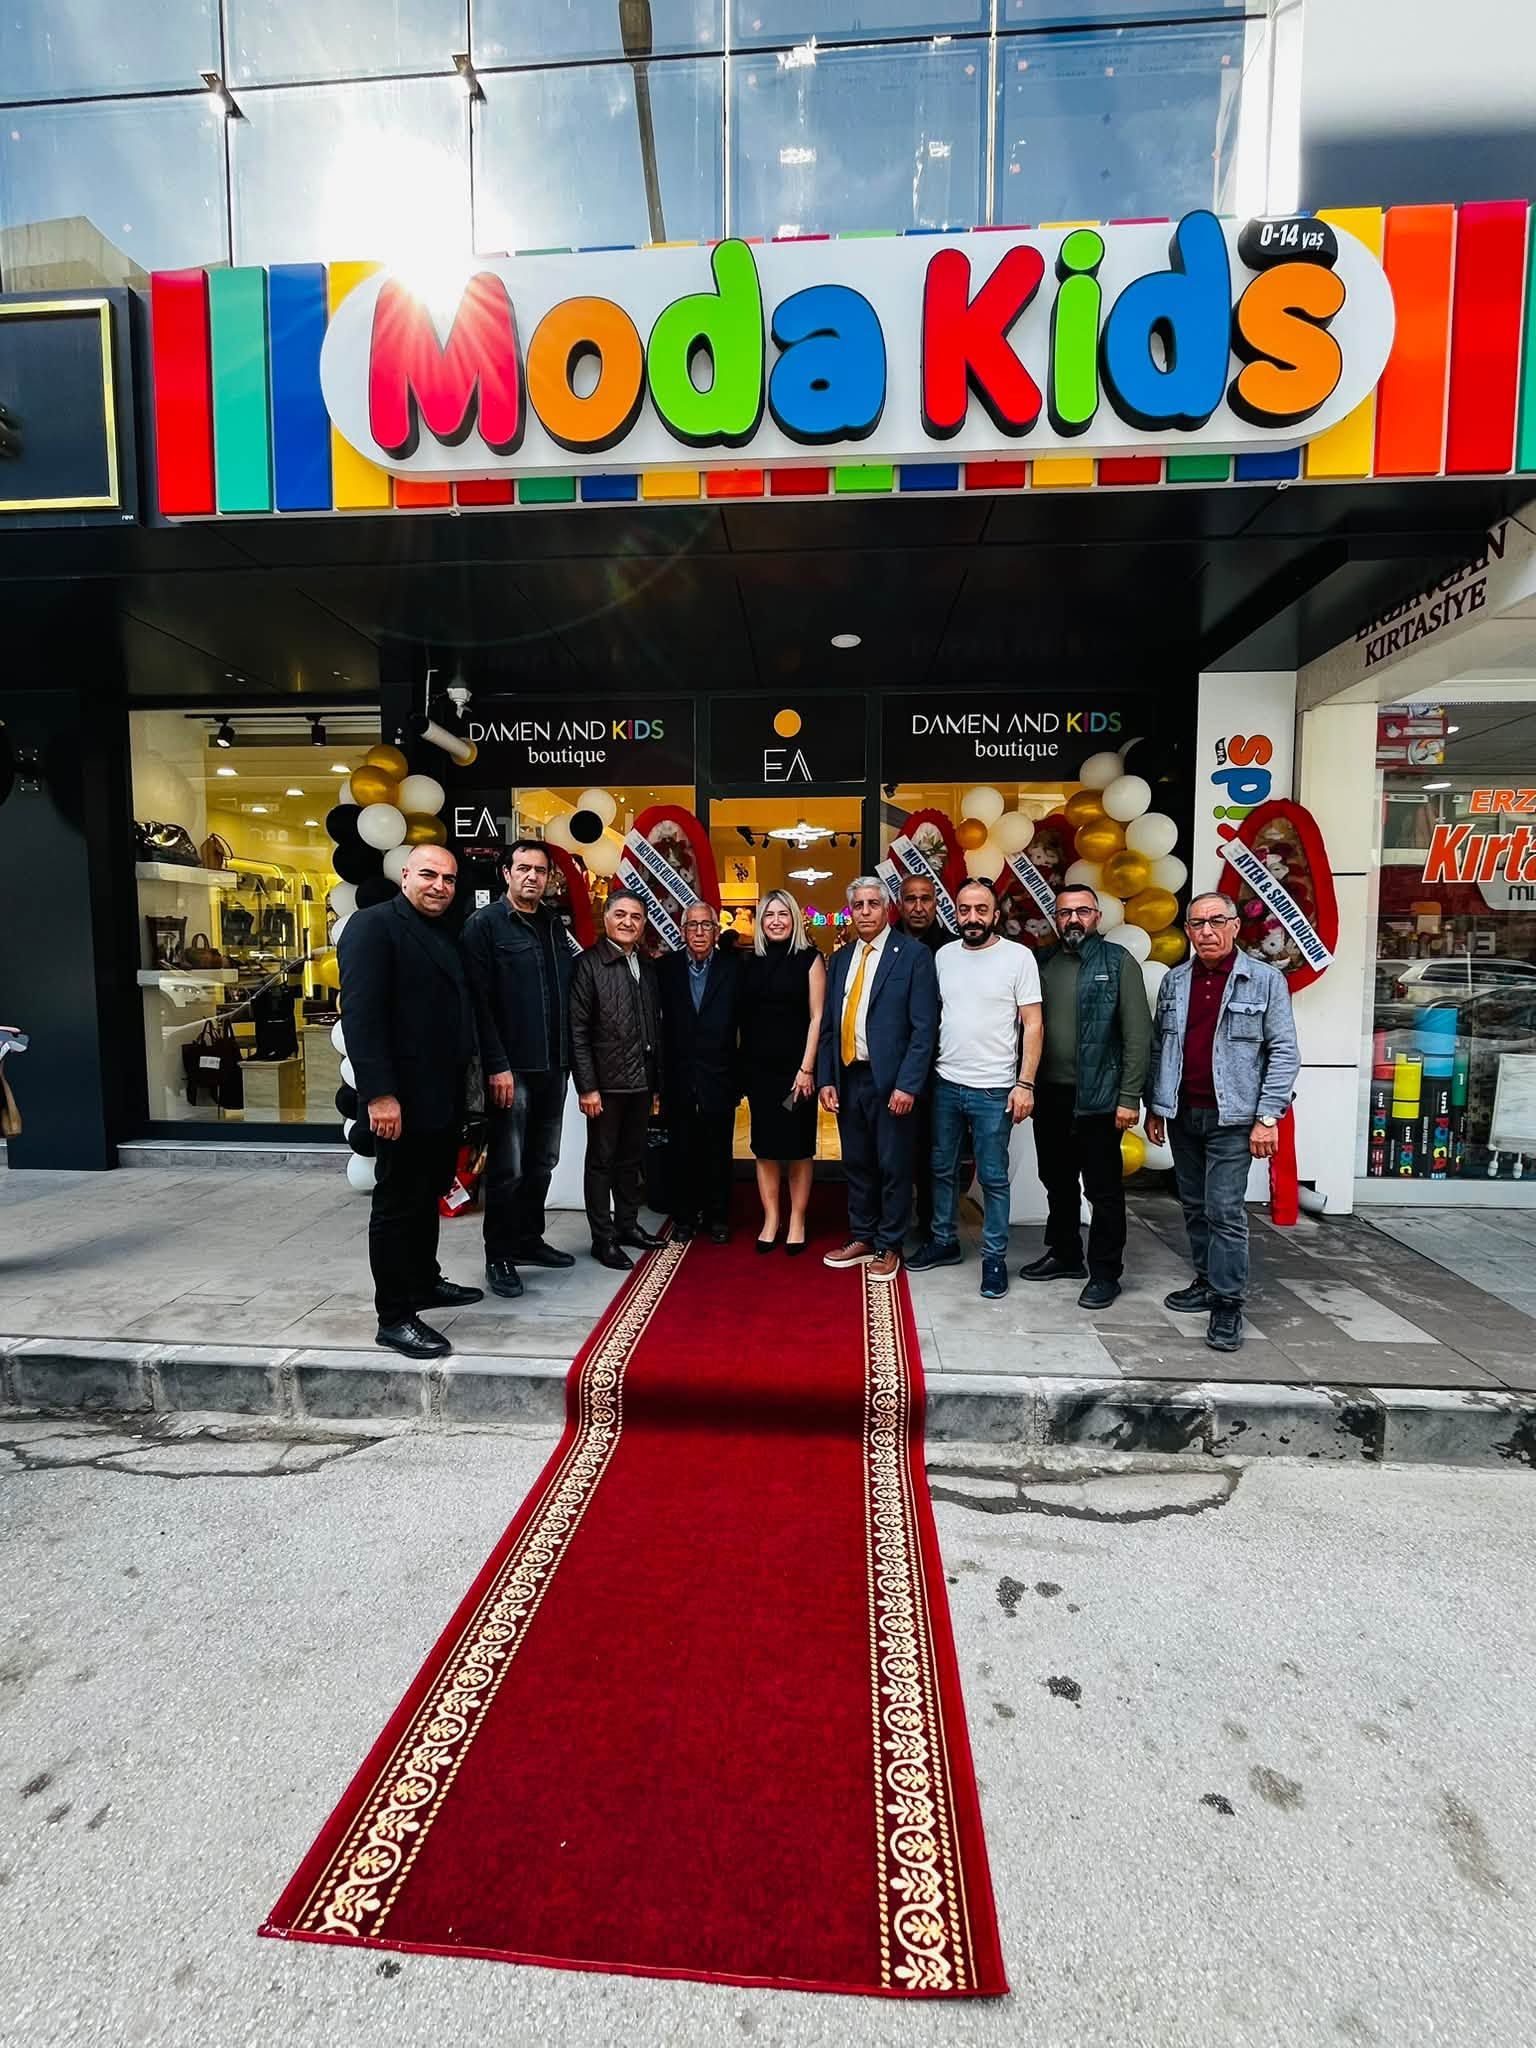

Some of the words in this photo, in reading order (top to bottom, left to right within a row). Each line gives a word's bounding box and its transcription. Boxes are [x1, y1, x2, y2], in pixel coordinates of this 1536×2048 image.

[1260, 224, 1299, 246] 0-14
[1302, 232, 1324, 250] yaş
[369, 238, 887, 456] Moda
[920, 209, 1346, 440] Kids
[1365, 577, 1487, 667] KIRTASİYE
[469, 721, 551, 742] DAMEN
[557, 720, 606, 741] AND
[612, 719, 665, 740] KIDS
[913, 714, 1000, 735] DAMEN
[1006, 713, 1059, 734] AND
[1066, 712, 1121, 733] KIDS
[528, 745, 606, 767] boutique
[764, 748, 813, 782] EA
[975, 738, 1059, 761] boutique
[1211, 734, 1273, 858] ids
[455, 806, 499, 837] EA
[1234, 853, 1269, 884] AYTEN
[1259, 881, 1272, 894] &
[1267, 888, 1300, 923] SADIK
[1290, 918, 1327, 963] DÜZGÜN
